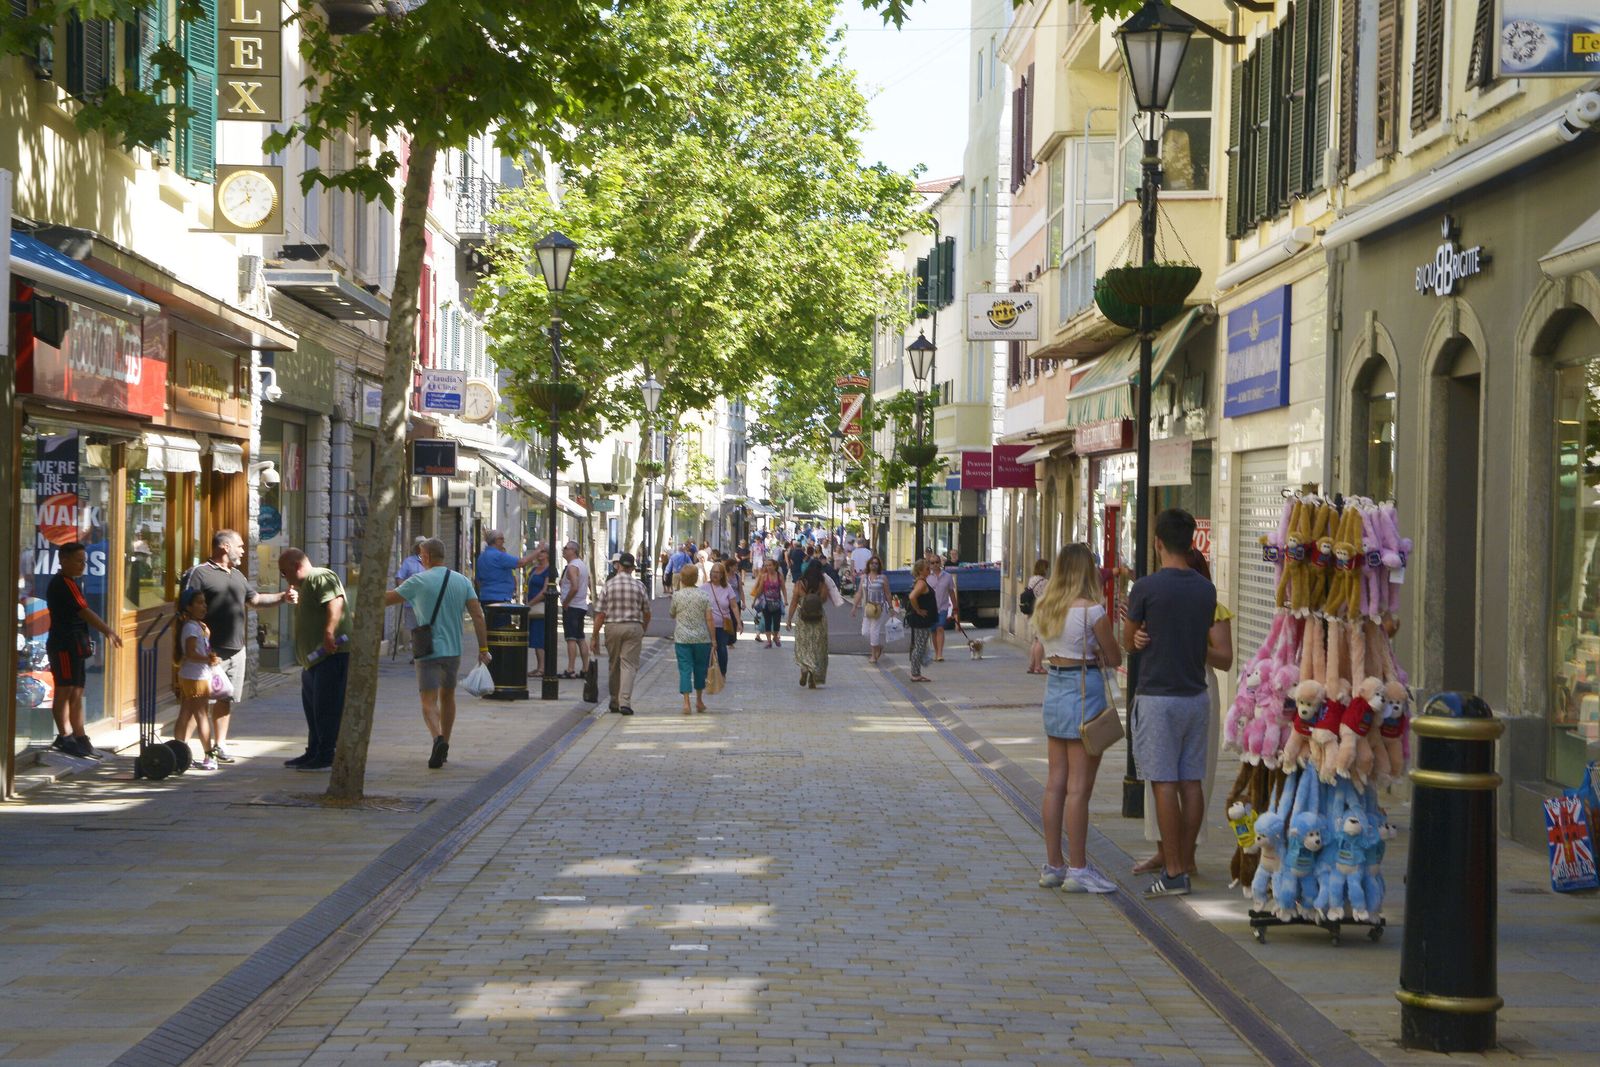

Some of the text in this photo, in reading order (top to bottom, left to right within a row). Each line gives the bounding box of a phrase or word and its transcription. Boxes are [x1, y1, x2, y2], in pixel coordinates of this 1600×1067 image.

[228, 0, 265, 114] LEX
[34, 461, 76, 475] WE'RE
[43, 473, 63, 483] THE
[34, 549, 106, 577] MAS
